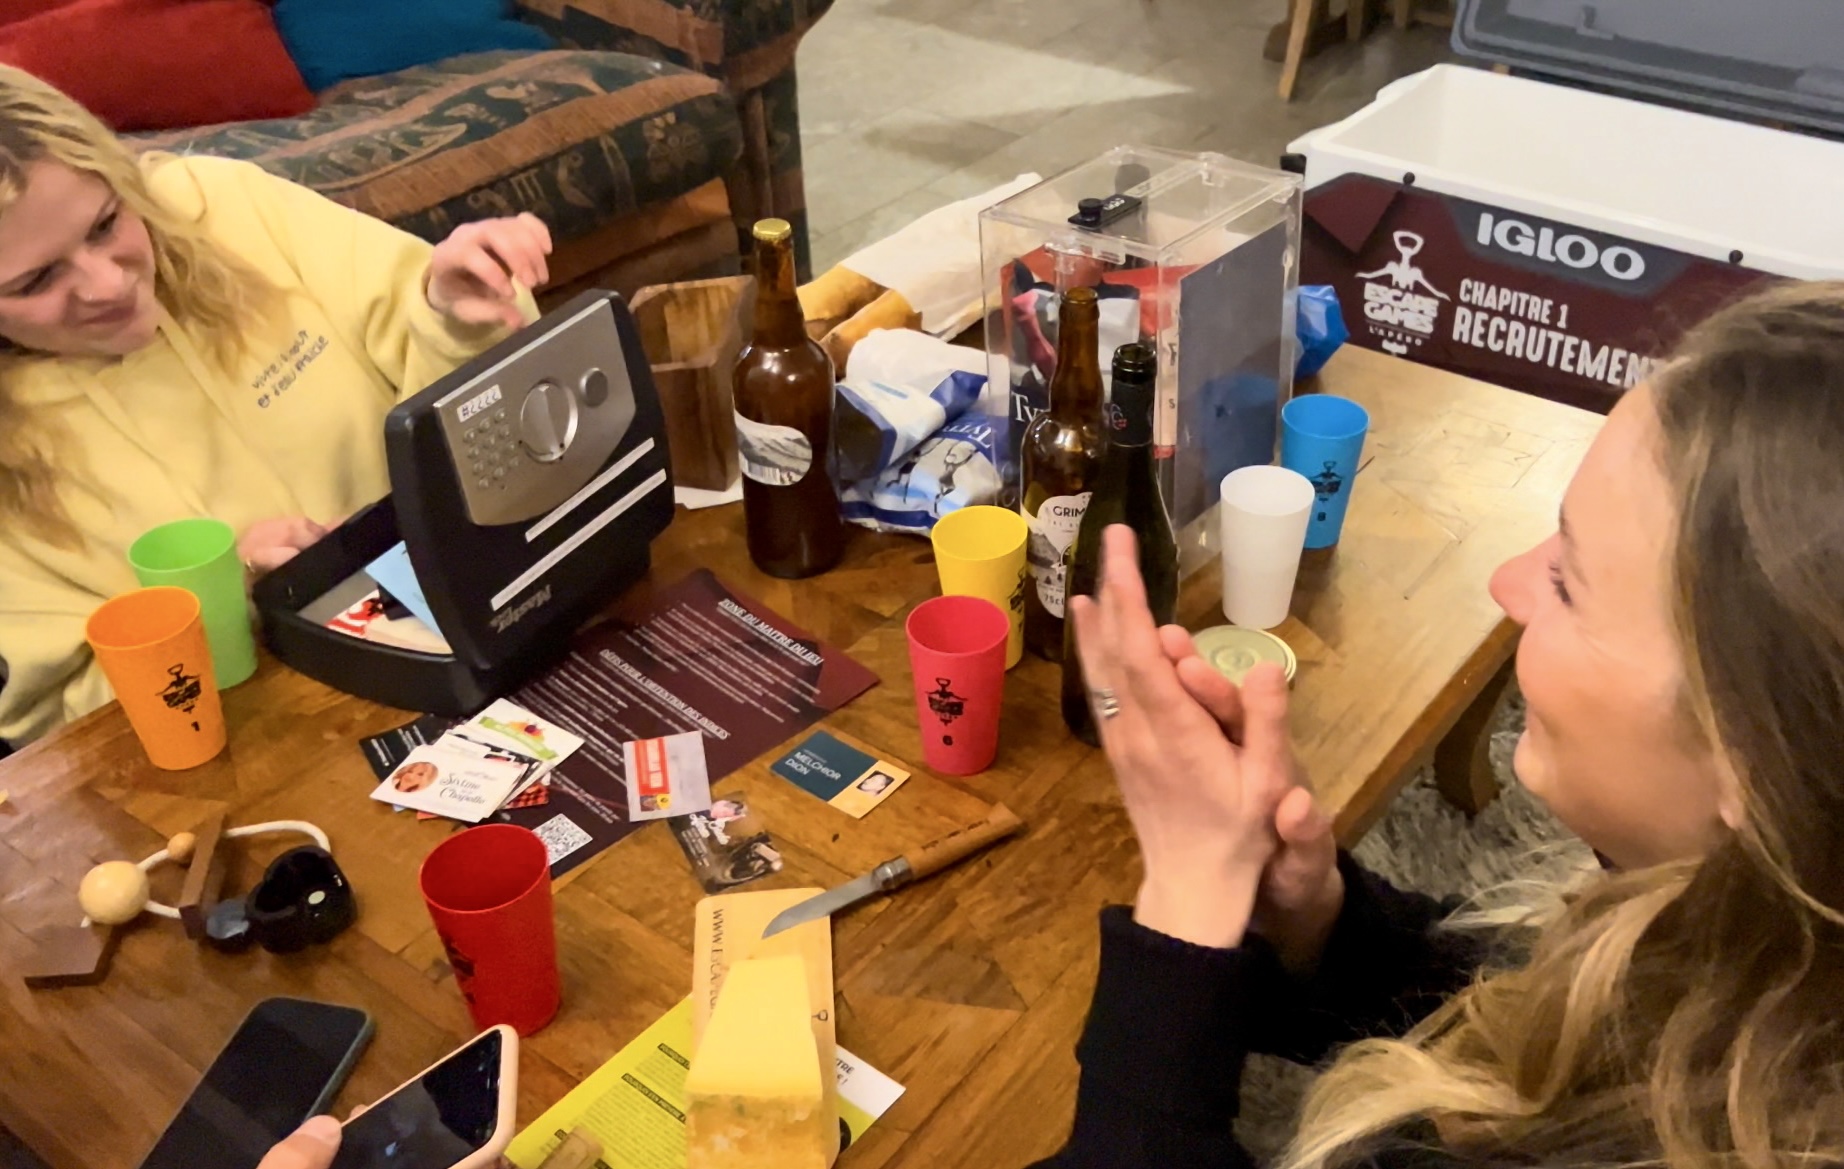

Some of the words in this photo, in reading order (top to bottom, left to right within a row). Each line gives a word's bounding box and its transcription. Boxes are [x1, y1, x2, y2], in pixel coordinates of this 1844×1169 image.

[1477, 213, 1645, 280] IGLOO
[1364, 282, 1439, 318] ESCAPE
[1459, 278, 1553, 326] CHAPITRE
[1556, 303, 1569, 329] 1
[1364, 302, 1435, 334] GAMES
[1053, 506, 1085, 517] GRIM
[717, 598, 747, 618] ZONE
[741, 613, 760, 626] DU
[789, 643, 807, 657] DU
[802, 651, 823, 666] JEU
[682, 707, 701, 721] DES
[784, 758, 810, 774] DION
[794, 751, 841, 780] MELCHIOR
[439, 772, 480, 790] Sixtine
[439, 787, 484, 803] Chapelle
